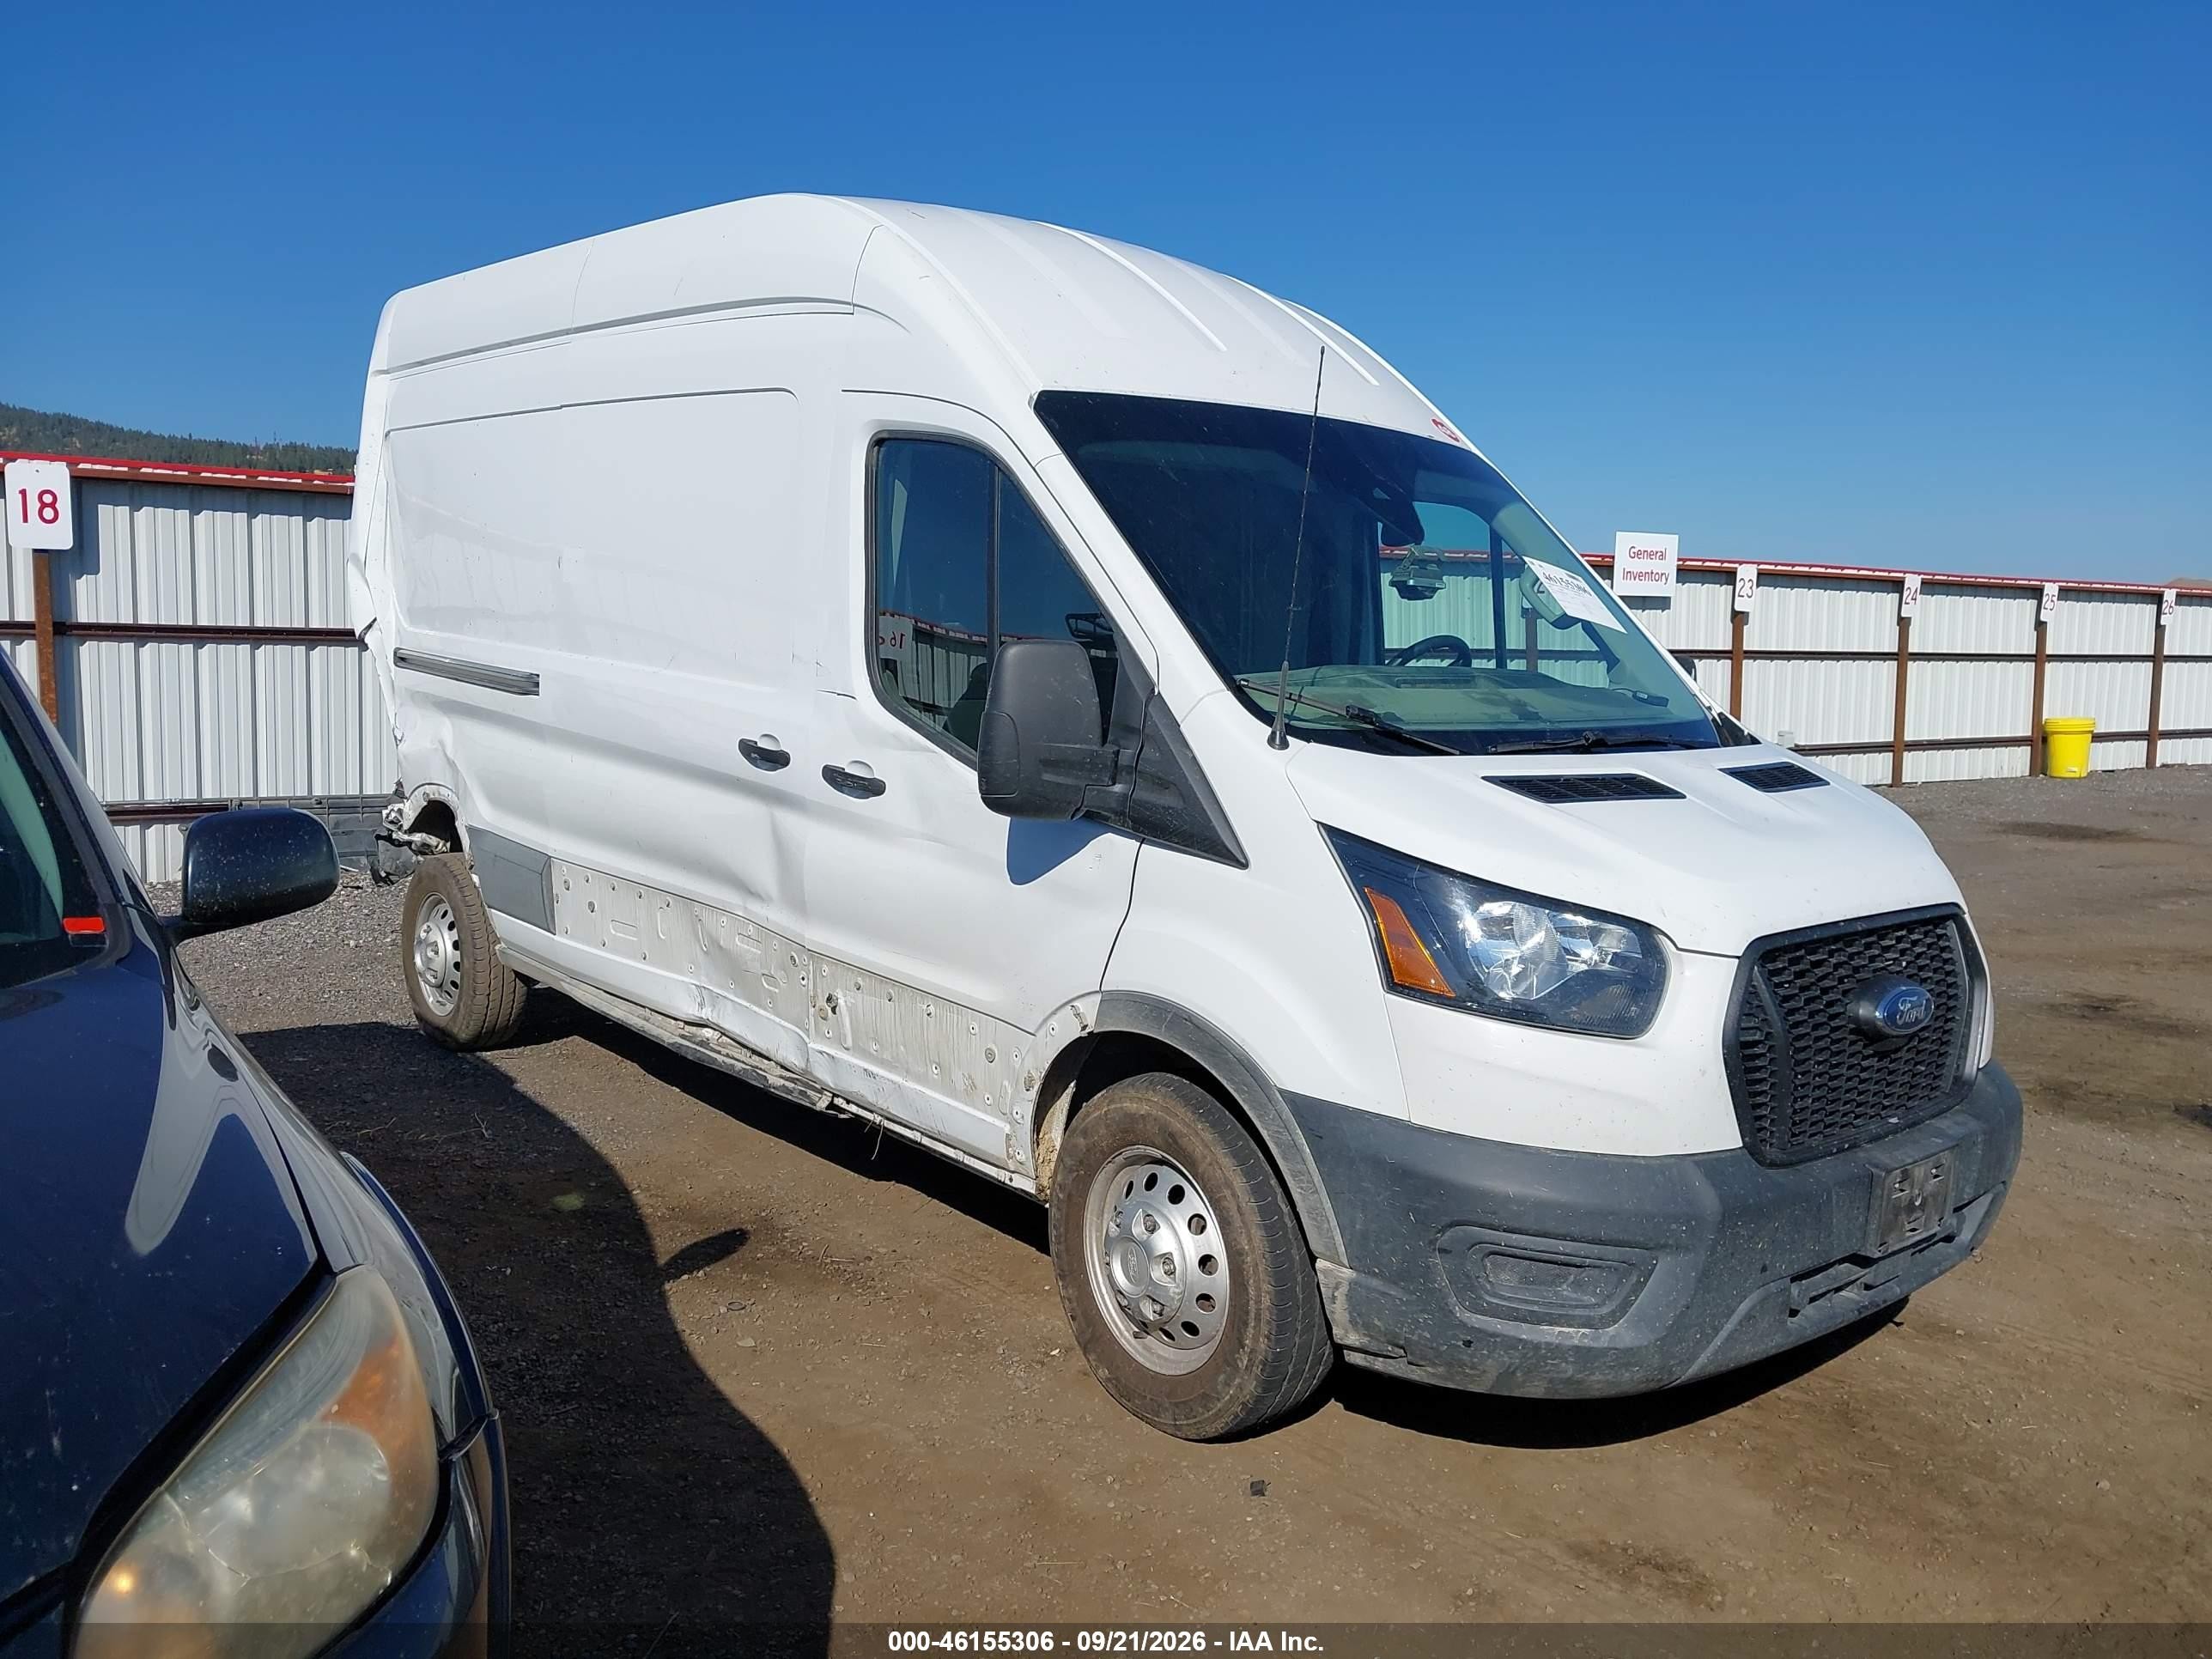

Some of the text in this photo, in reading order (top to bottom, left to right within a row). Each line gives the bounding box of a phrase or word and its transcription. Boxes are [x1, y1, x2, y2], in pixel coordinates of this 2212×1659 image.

[18, 488, 59, 525] 18
[1628, 545, 1667, 561] General
[1622, 567, 1670, 586] Inventory
[1737, 577, 1753, 599] 23
[1904, 586, 1918, 605] 24
[2043, 592, 2056, 611] 25
[2161, 599, 2174, 616] 26
[1896, 995, 1926, 1025] Ford
